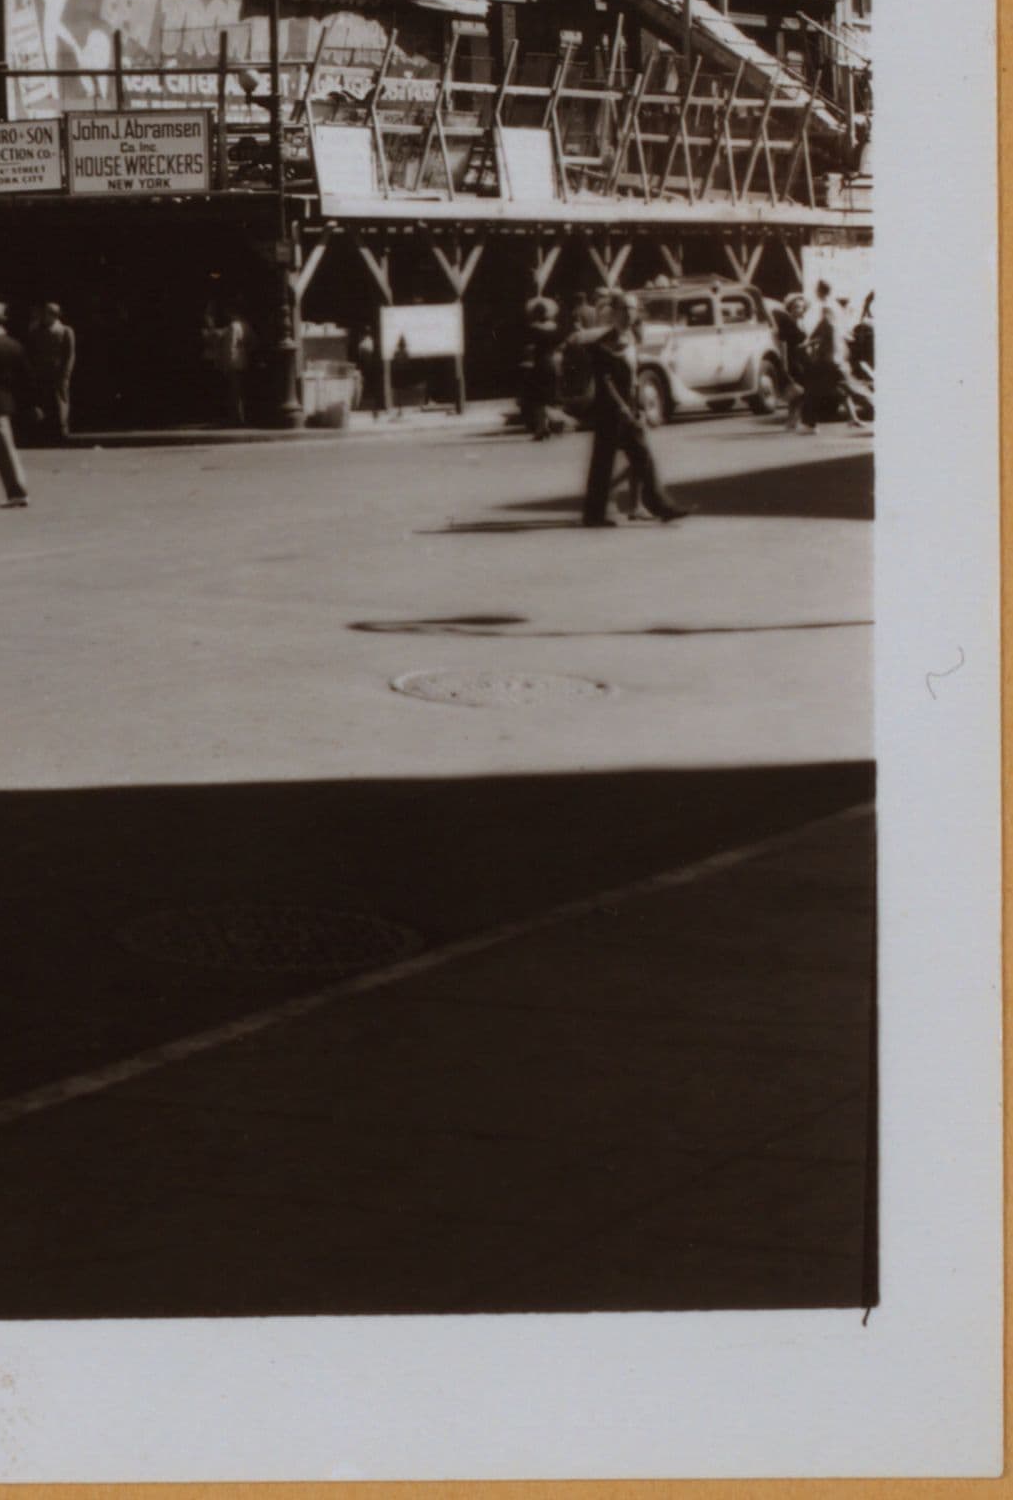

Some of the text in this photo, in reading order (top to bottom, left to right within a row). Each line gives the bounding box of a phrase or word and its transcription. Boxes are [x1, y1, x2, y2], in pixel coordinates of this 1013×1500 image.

[26, 126, 53, 144] SON
[72, 119, 109, 141] John
[124, 118, 201, 139] Abramsen
[74, 153, 204, 178] HOUSE WRECKERS
[22, 174, 44, 184] CITY
[107, 178, 172, 190] NEW YORK
